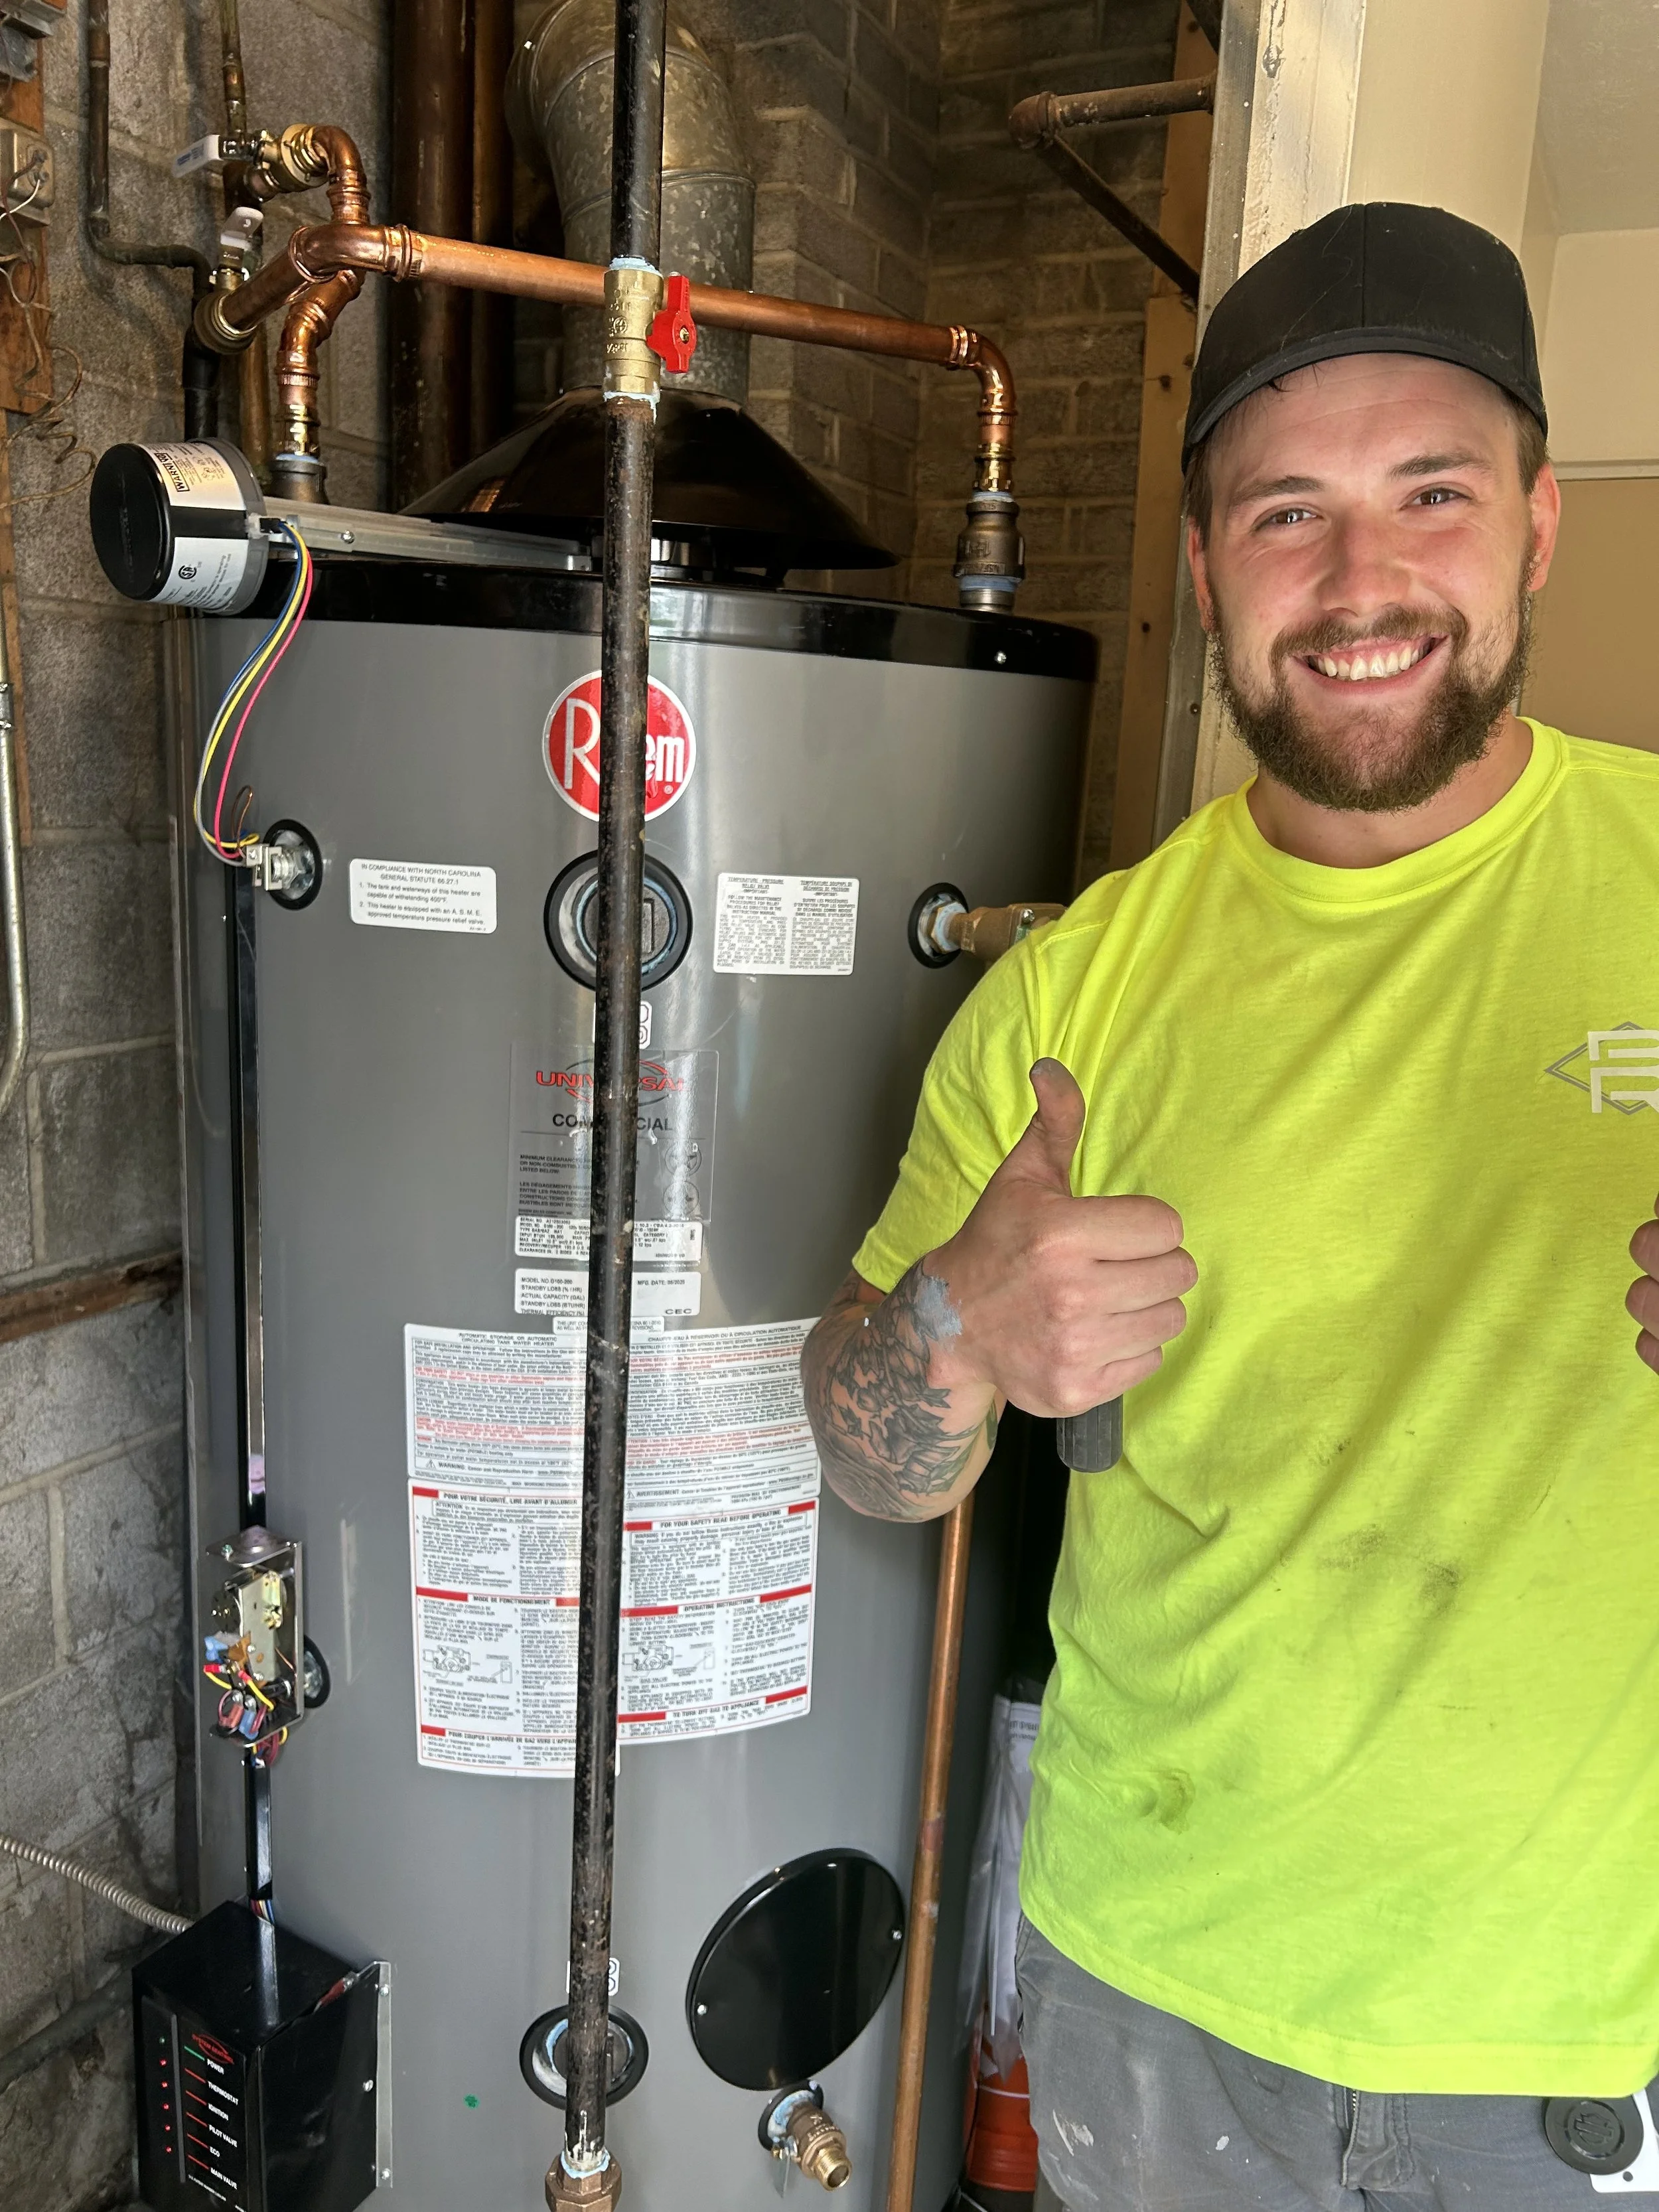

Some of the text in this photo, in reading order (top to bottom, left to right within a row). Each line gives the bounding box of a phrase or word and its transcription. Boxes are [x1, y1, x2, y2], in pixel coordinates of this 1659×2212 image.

[565, 697, 685, 790] Rem
[380, 873, 408, 882] GENERAL
[690, 1518, 712, 1526] SAFETY
[729, 1513, 750, 1522] BEFORE
[752, 1509, 782, 1520] OPERATING
[716, 1597, 755, 1608] INSTRUCTIONS
[206, 2058, 224, 2075] POWER
[207, 2080, 239, 2106] THERMOSTAT
[208, 2102, 229, 2121] IGNITION
[208, 2124, 238, 2148] PILOT VALVE
[210, 2146, 221, 2158] ECO
[210, 2167, 223, 2180] MAIN
[223, 2175, 238, 2190] VALVE
